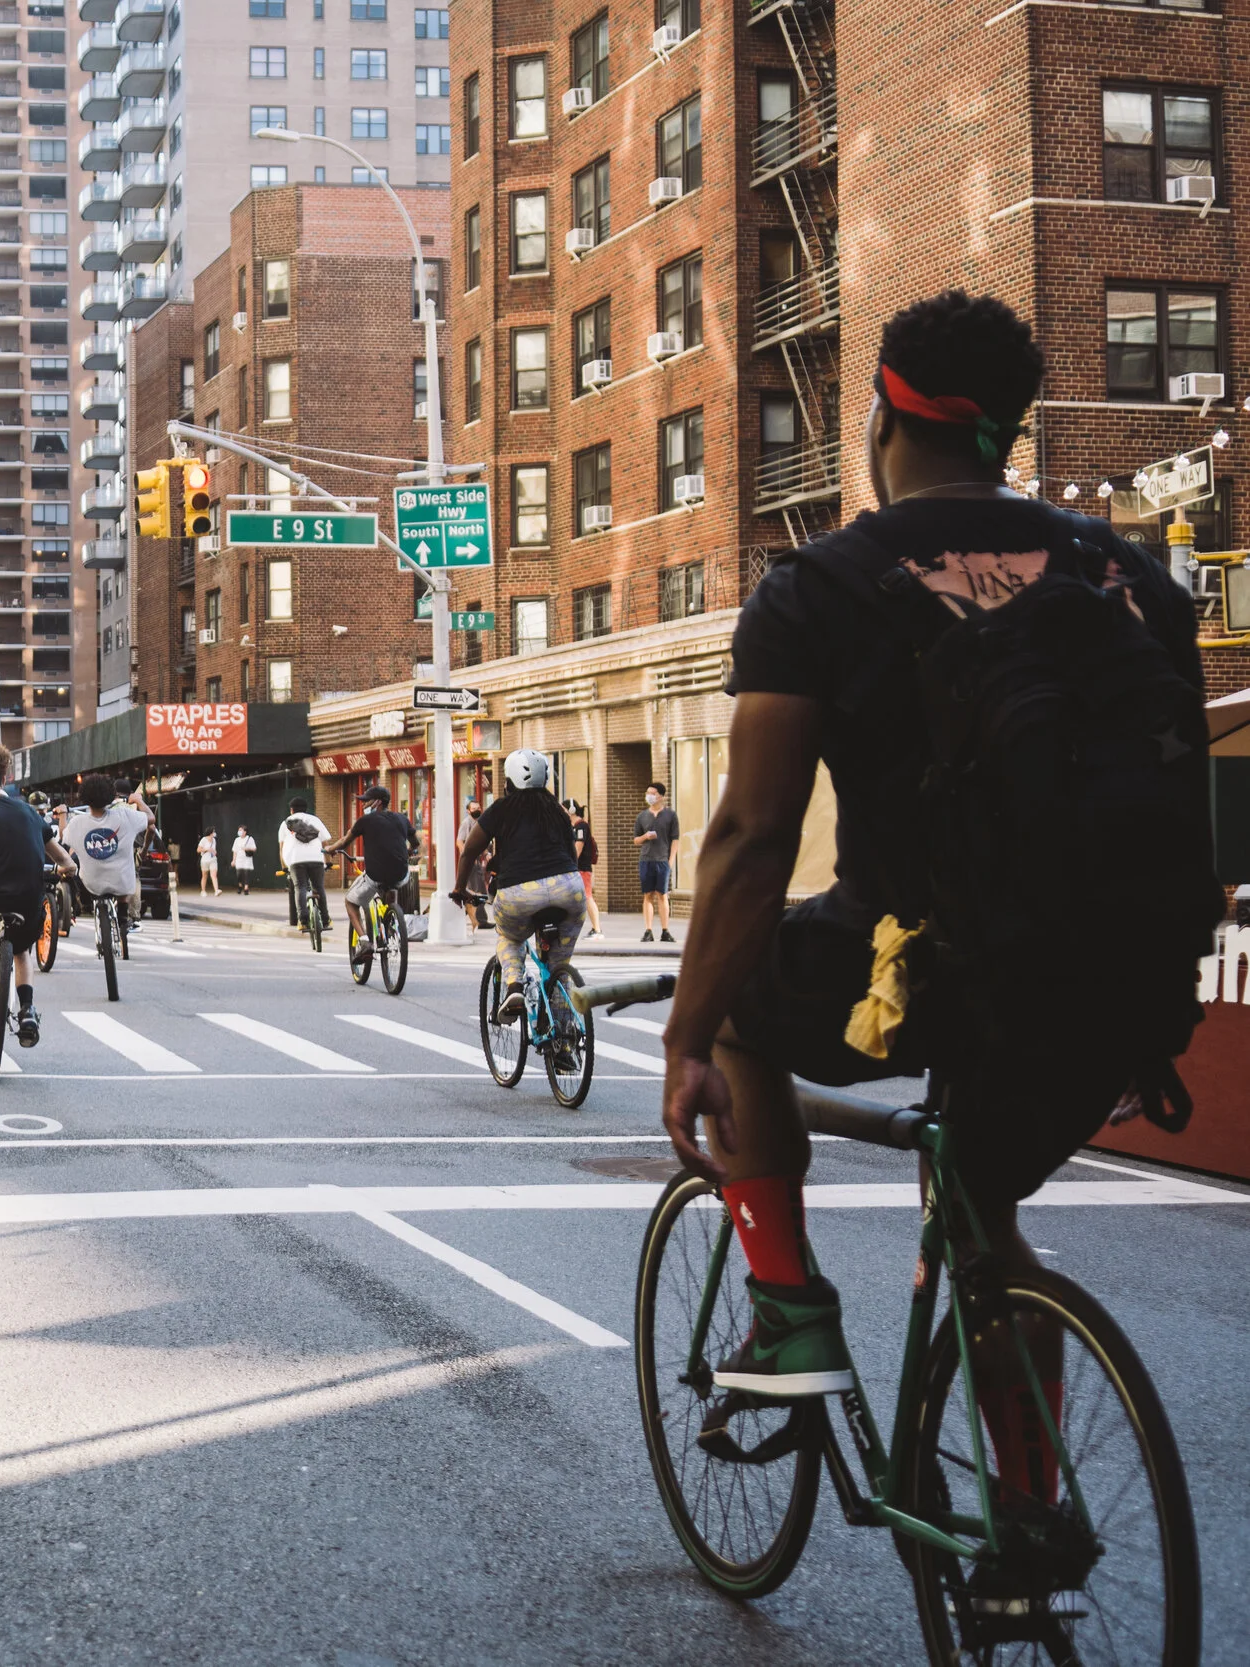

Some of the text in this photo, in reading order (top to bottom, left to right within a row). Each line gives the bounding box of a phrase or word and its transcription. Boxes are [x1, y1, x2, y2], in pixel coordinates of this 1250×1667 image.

[1150, 466, 1202, 498] ONE WAY
[401, 489, 485, 507] 9A West Side
[438, 505, 467, 520] Hwy
[273, 519, 333, 540] E 9 St
[402, 526, 440, 539] South
[448, 524, 484, 536] North
[457, 613, 486, 628] E 9 St
[420, 692, 471, 703] ONE WAY
[149, 703, 246, 726] STAPLES
[172, 726, 223, 739] We Are
[177, 738, 217, 753] Open
[389, 748, 416, 766] STAPLES
[86, 838, 117, 850] NASA
